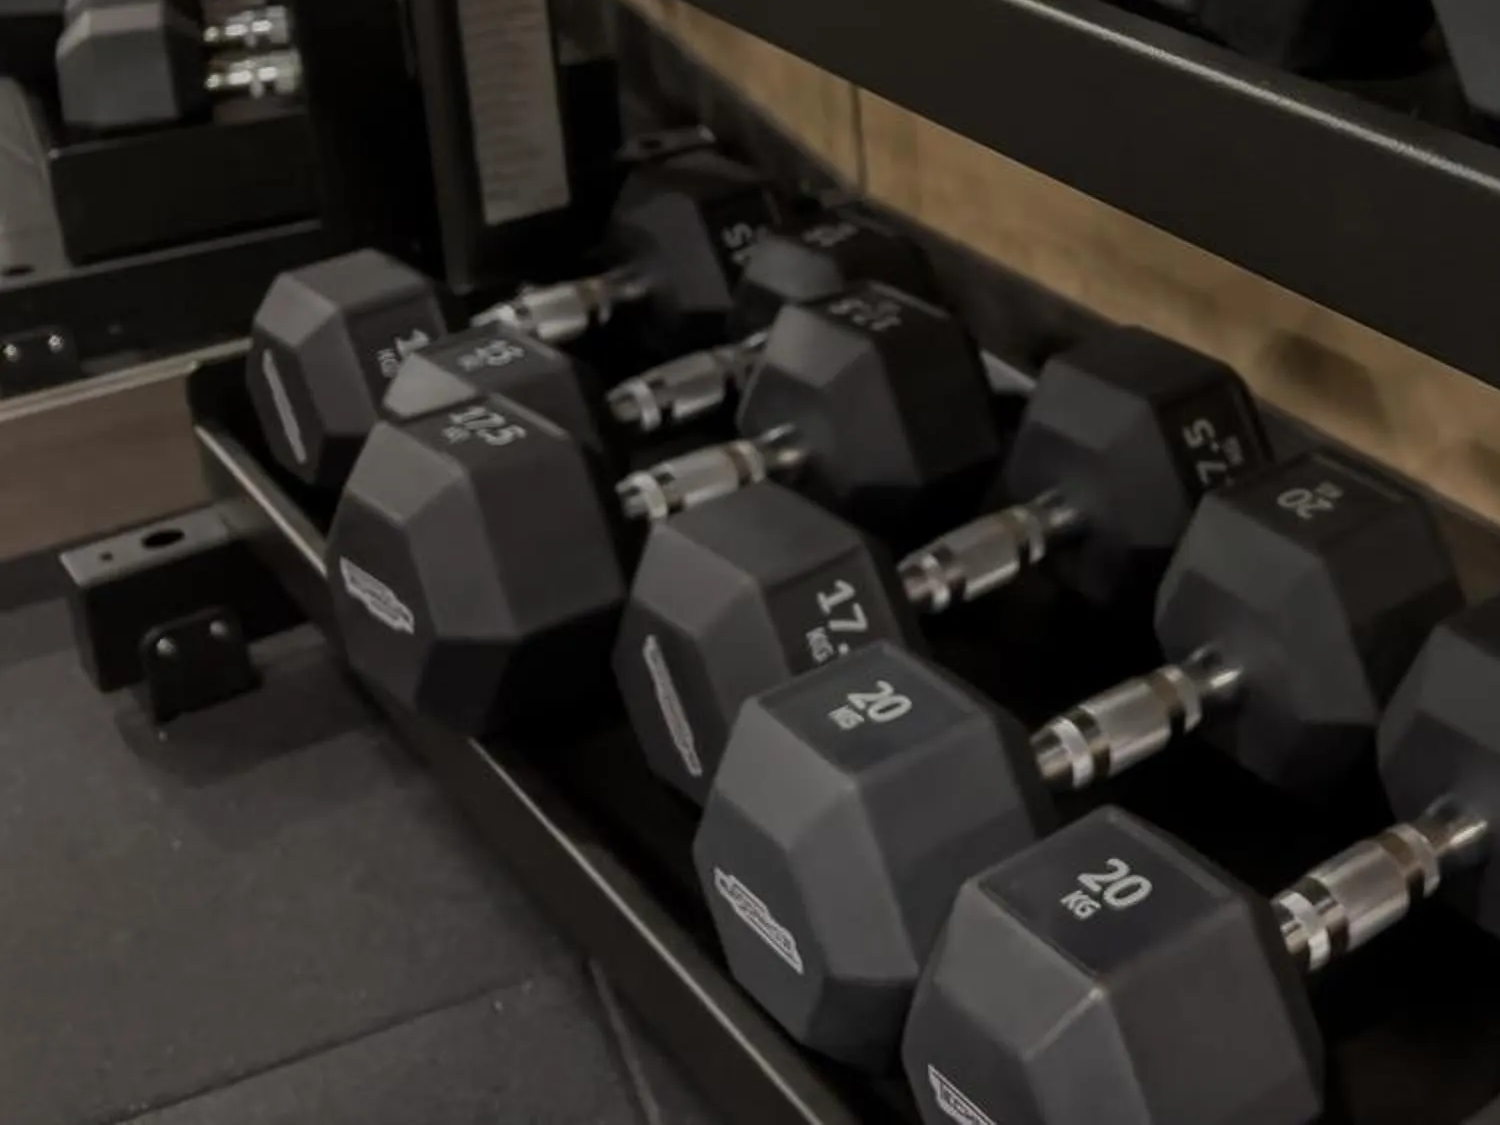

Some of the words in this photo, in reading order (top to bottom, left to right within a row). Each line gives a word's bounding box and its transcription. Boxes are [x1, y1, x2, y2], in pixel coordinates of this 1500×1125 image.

[1277, 488, 1335, 520] 20
[817, 579, 869, 656] 17.
[847, 679, 912, 723] 20
[1060, 890, 1102, 920] KG
[1077, 858, 1153, 909] 20
